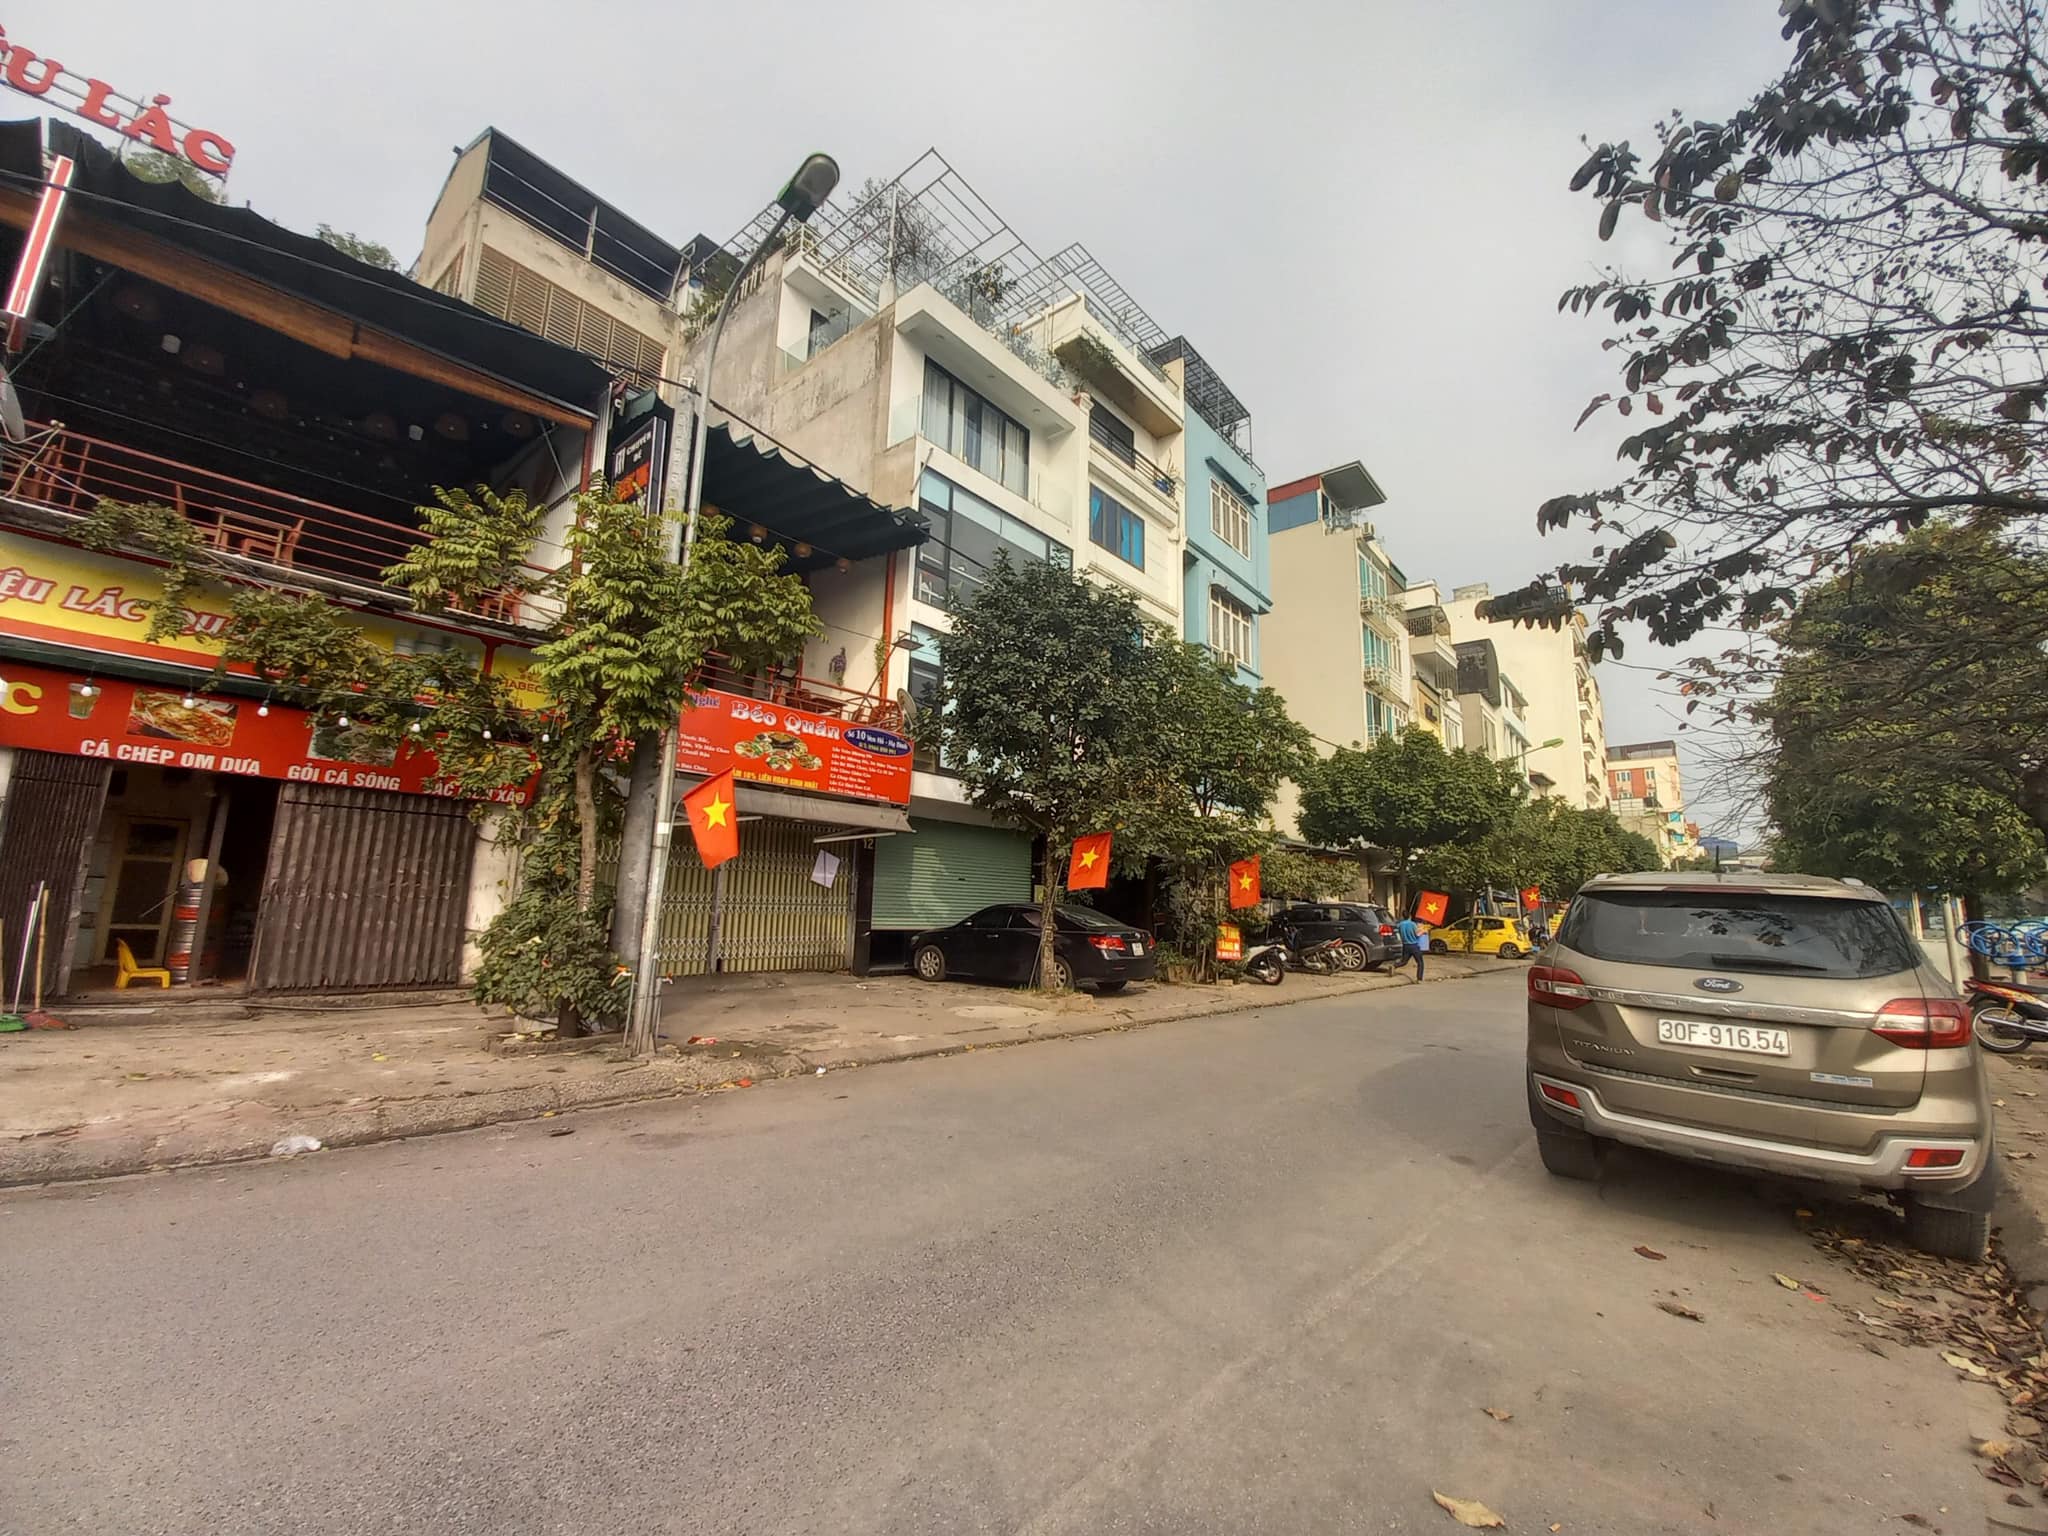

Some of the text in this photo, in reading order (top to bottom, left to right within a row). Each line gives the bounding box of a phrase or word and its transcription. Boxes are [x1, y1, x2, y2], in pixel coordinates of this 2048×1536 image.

[59, 586, 147, 622] LÁC
[730, 700, 840, 741] Béo Quán
[856, 730, 866, 740] 10
[80, 739, 261, 776] CÁ CHÉP OM DƯA
[287, 762, 401, 791] GỎI CÁ SÔNG
[1572, 1039, 1636, 1056] TITANIUM
[1660, 1020, 1786, 1052] 30F-916.54
